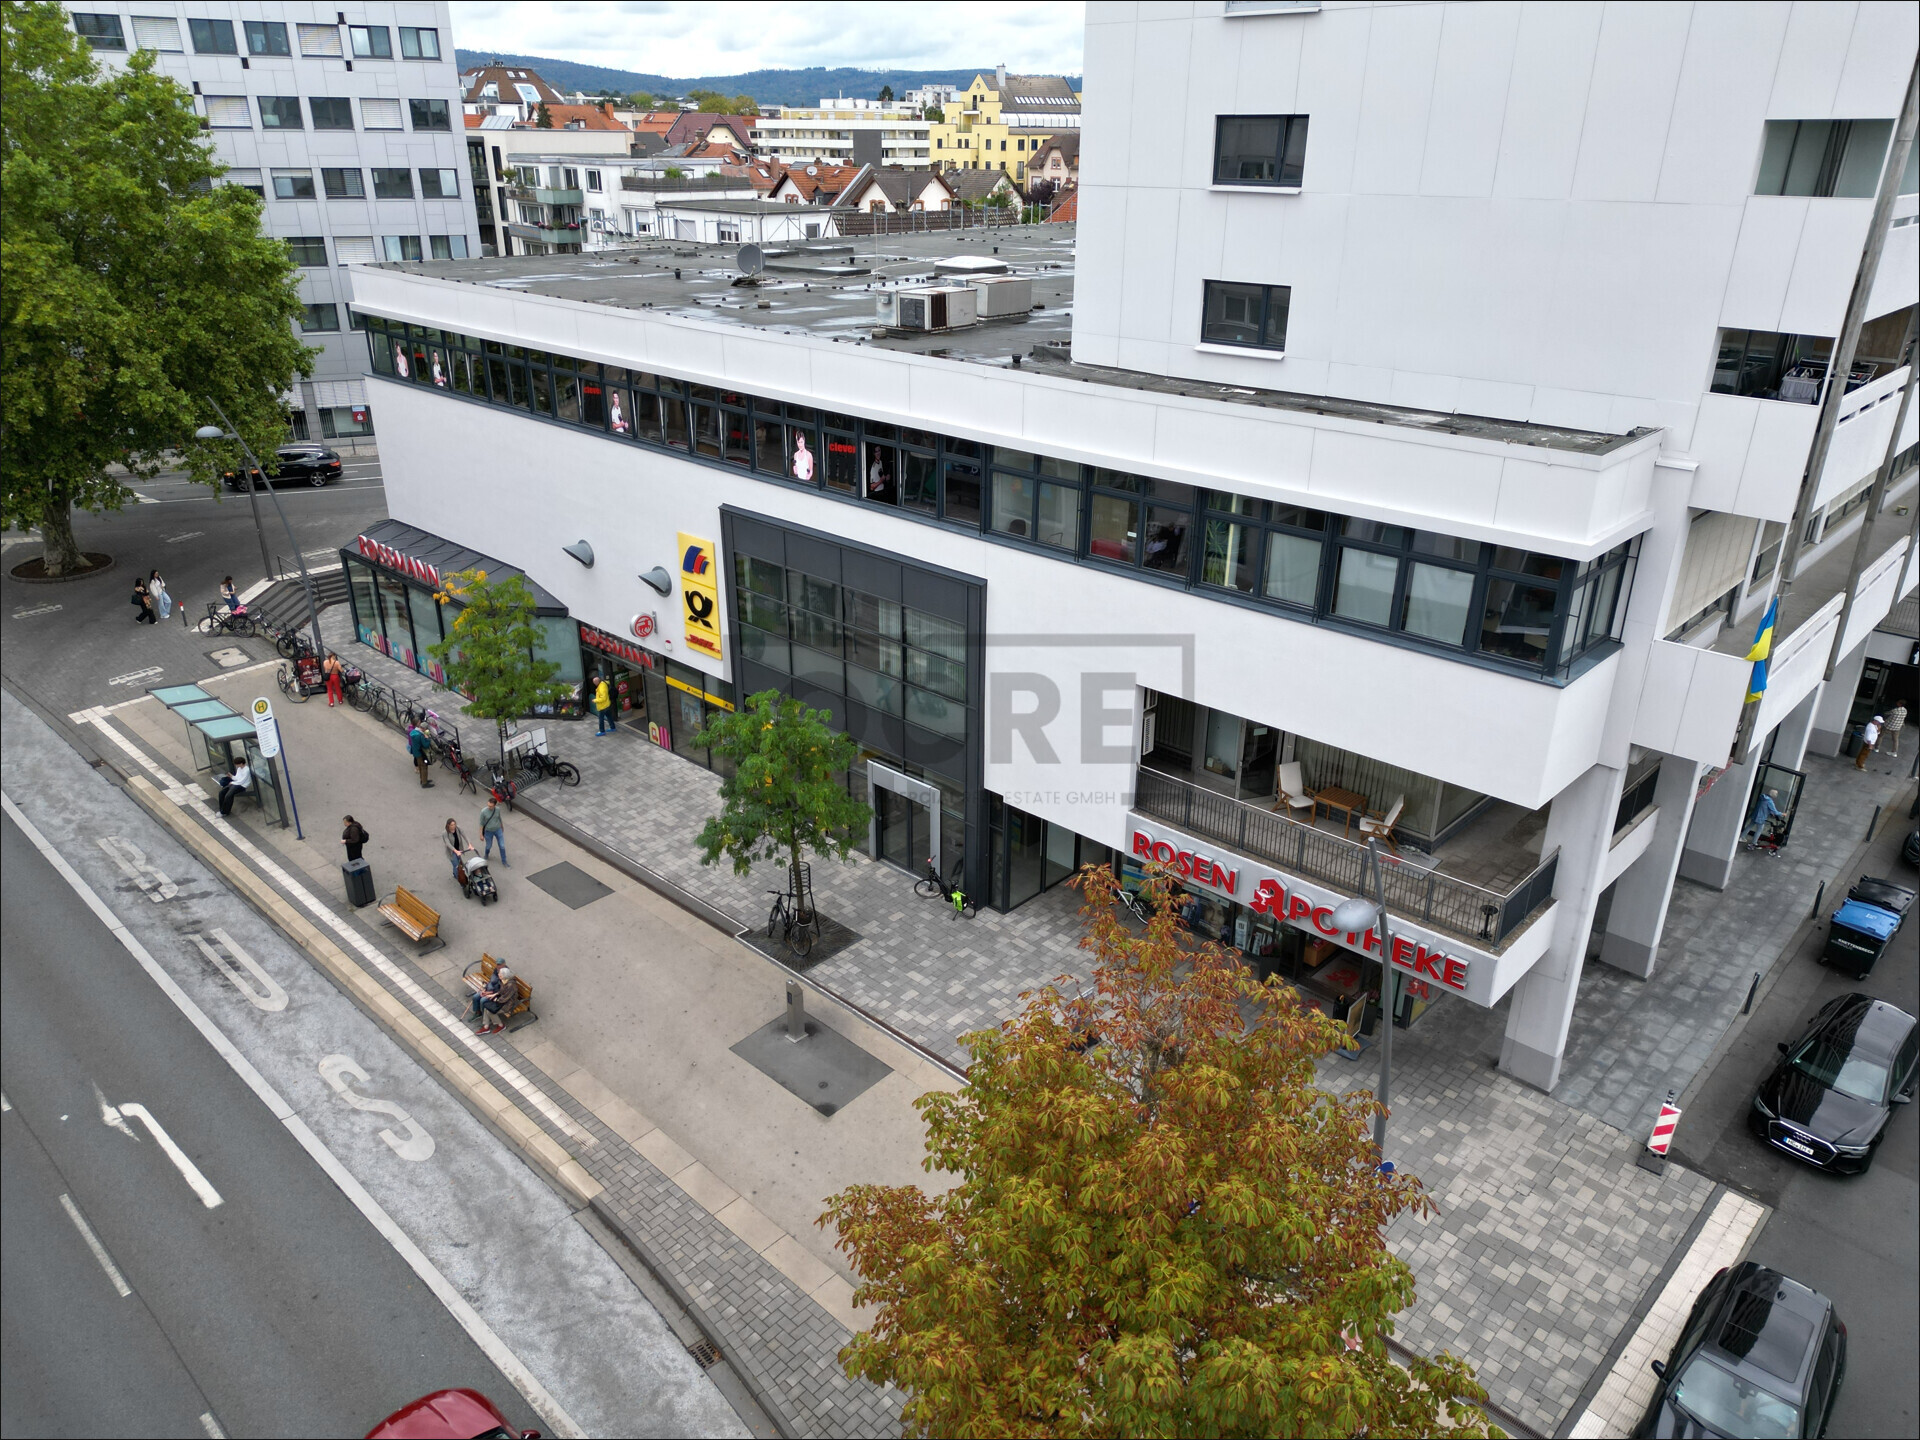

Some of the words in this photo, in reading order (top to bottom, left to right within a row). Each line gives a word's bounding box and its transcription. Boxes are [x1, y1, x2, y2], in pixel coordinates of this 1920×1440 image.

[358, 534, 440, 588] ROSSMANN
[580, 626, 654, 669] ROSSMANN
[1133, 828, 1240, 895] ROSEN
[95, 834, 436, 1162] BUS
